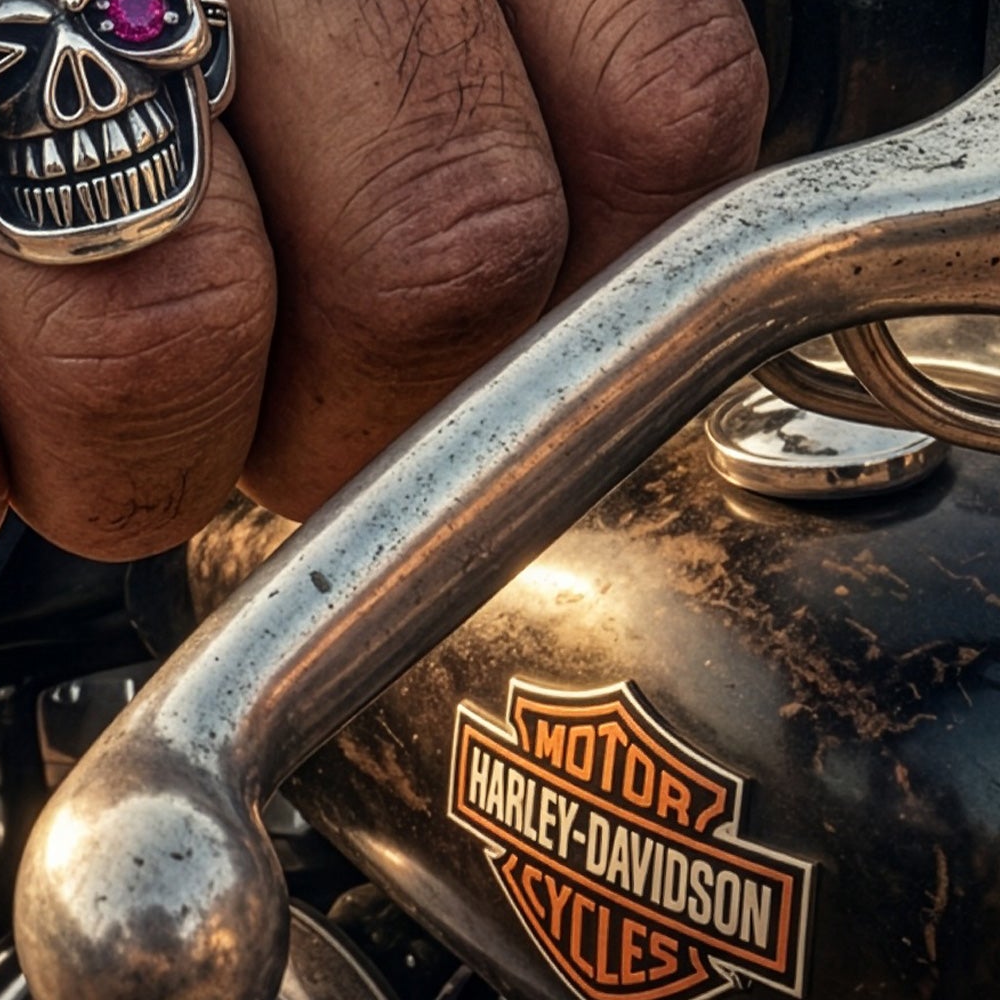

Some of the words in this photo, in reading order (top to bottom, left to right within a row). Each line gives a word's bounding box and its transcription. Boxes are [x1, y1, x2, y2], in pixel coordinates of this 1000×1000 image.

[535, 718, 692, 824] MOTOR
[468, 746, 773, 950] HARLEY-DAVIDSON
[521, 863, 679, 985] CYCLES
